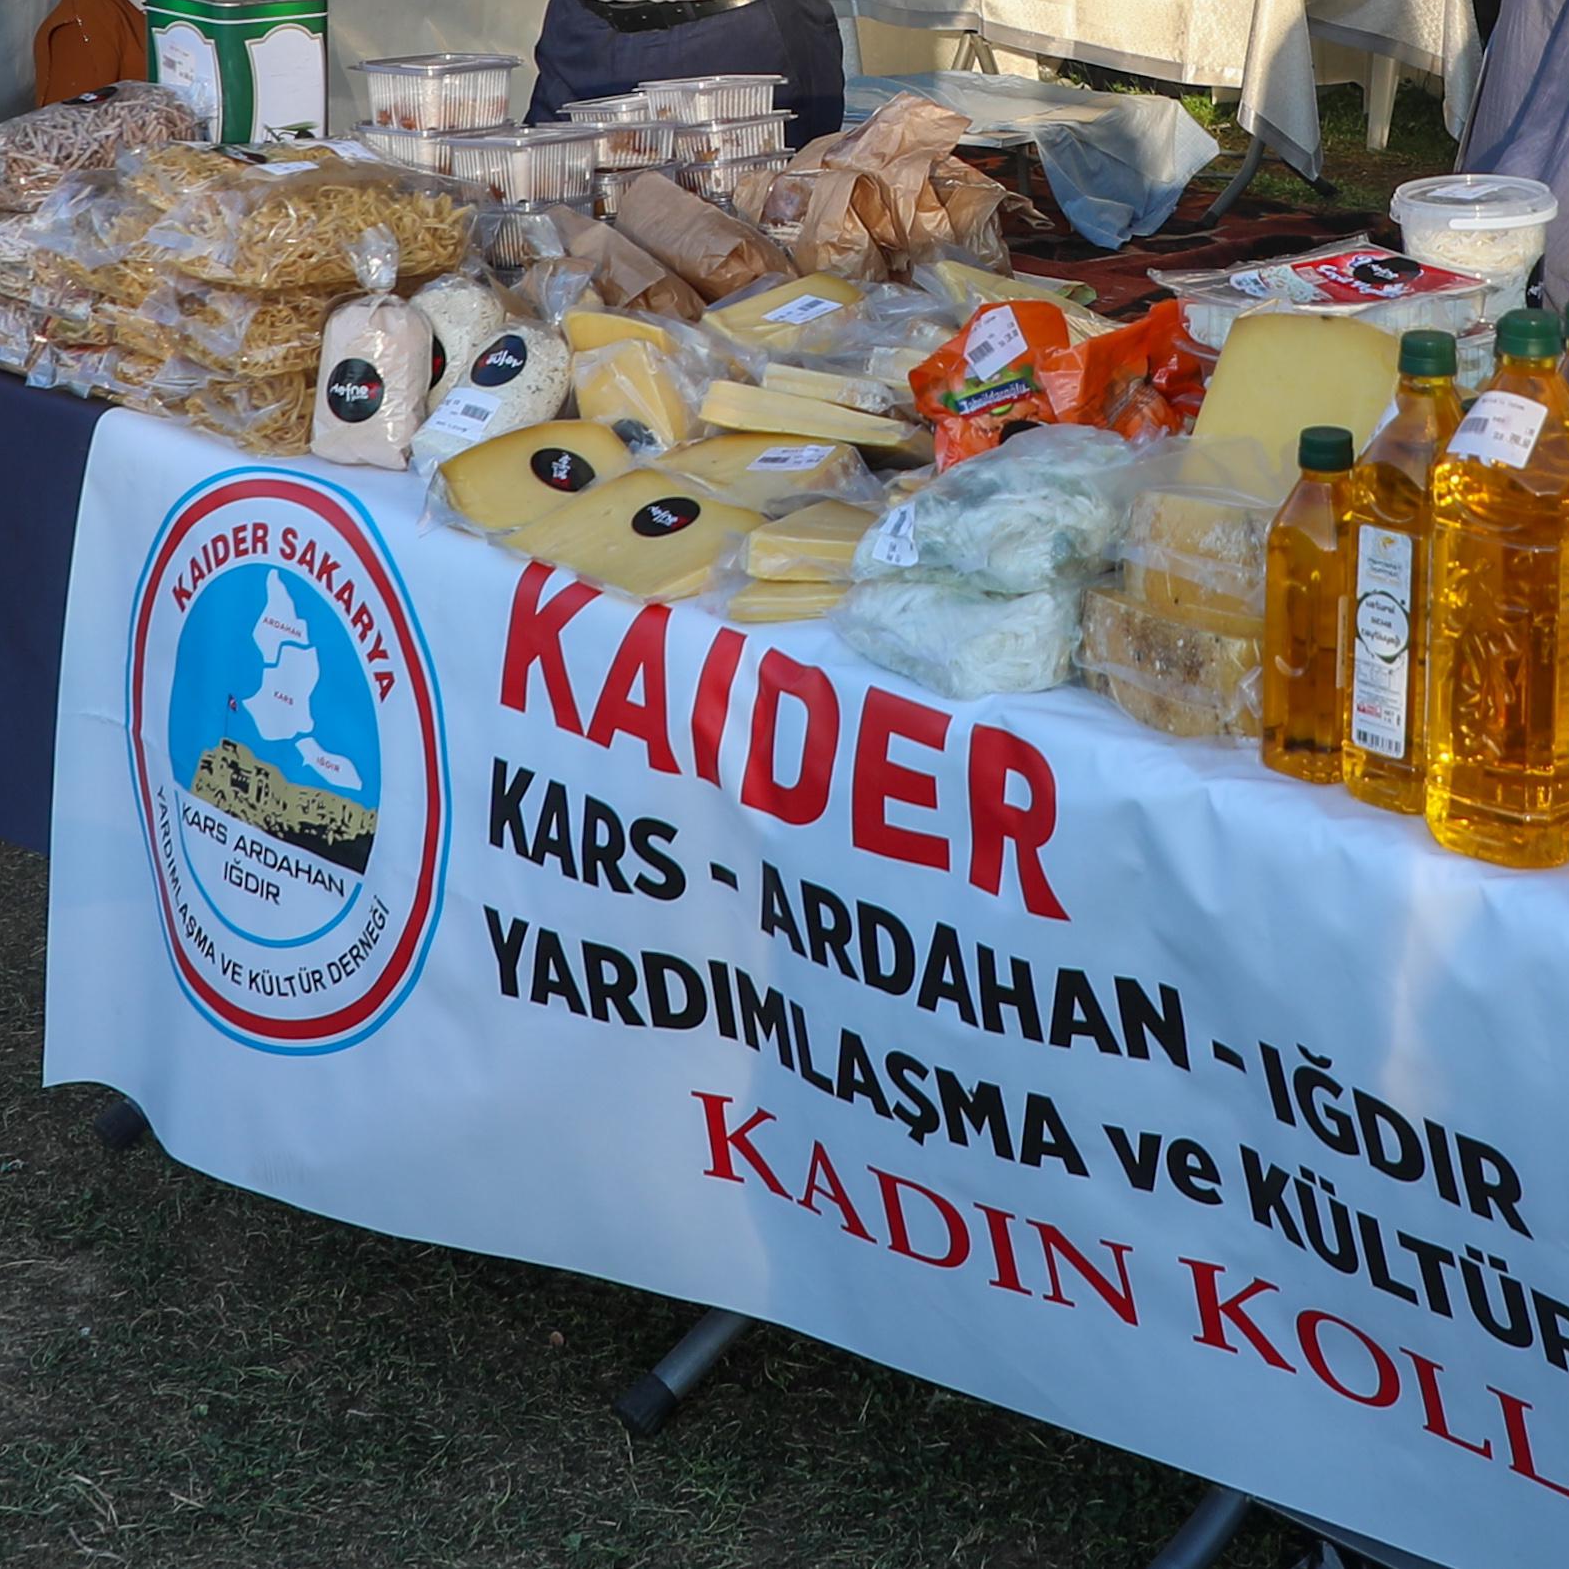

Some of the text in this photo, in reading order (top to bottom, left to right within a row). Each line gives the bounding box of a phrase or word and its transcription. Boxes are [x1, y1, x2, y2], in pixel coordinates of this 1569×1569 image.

[172, 522, 396, 704] KAIDER SAKARYA
[262, 616, 303, 638] ARDAHAN
[273, 690, 295, 706] KARS
[499, 560, 1072, 922] KAIDER
[157, 786, 391, 998] YARDIMLAŞMA VE KÜLTÜR DERNEĞİ
[182, 802, 346, 898] KARS ARDAHAN
[222, 858, 281, 906] IĞDIR
[482, 904, 1090, 1180] YARDIMLAŞMA
[1101, 1123, 1224, 1207] ve
[487, 756, 687, 902] KARS
[760, 859, 1193, 1072] ARDAHAN
[1257, 1039, 1534, 1241] IĞDIR
[689, 1089, 1140, 1327] KADIN
